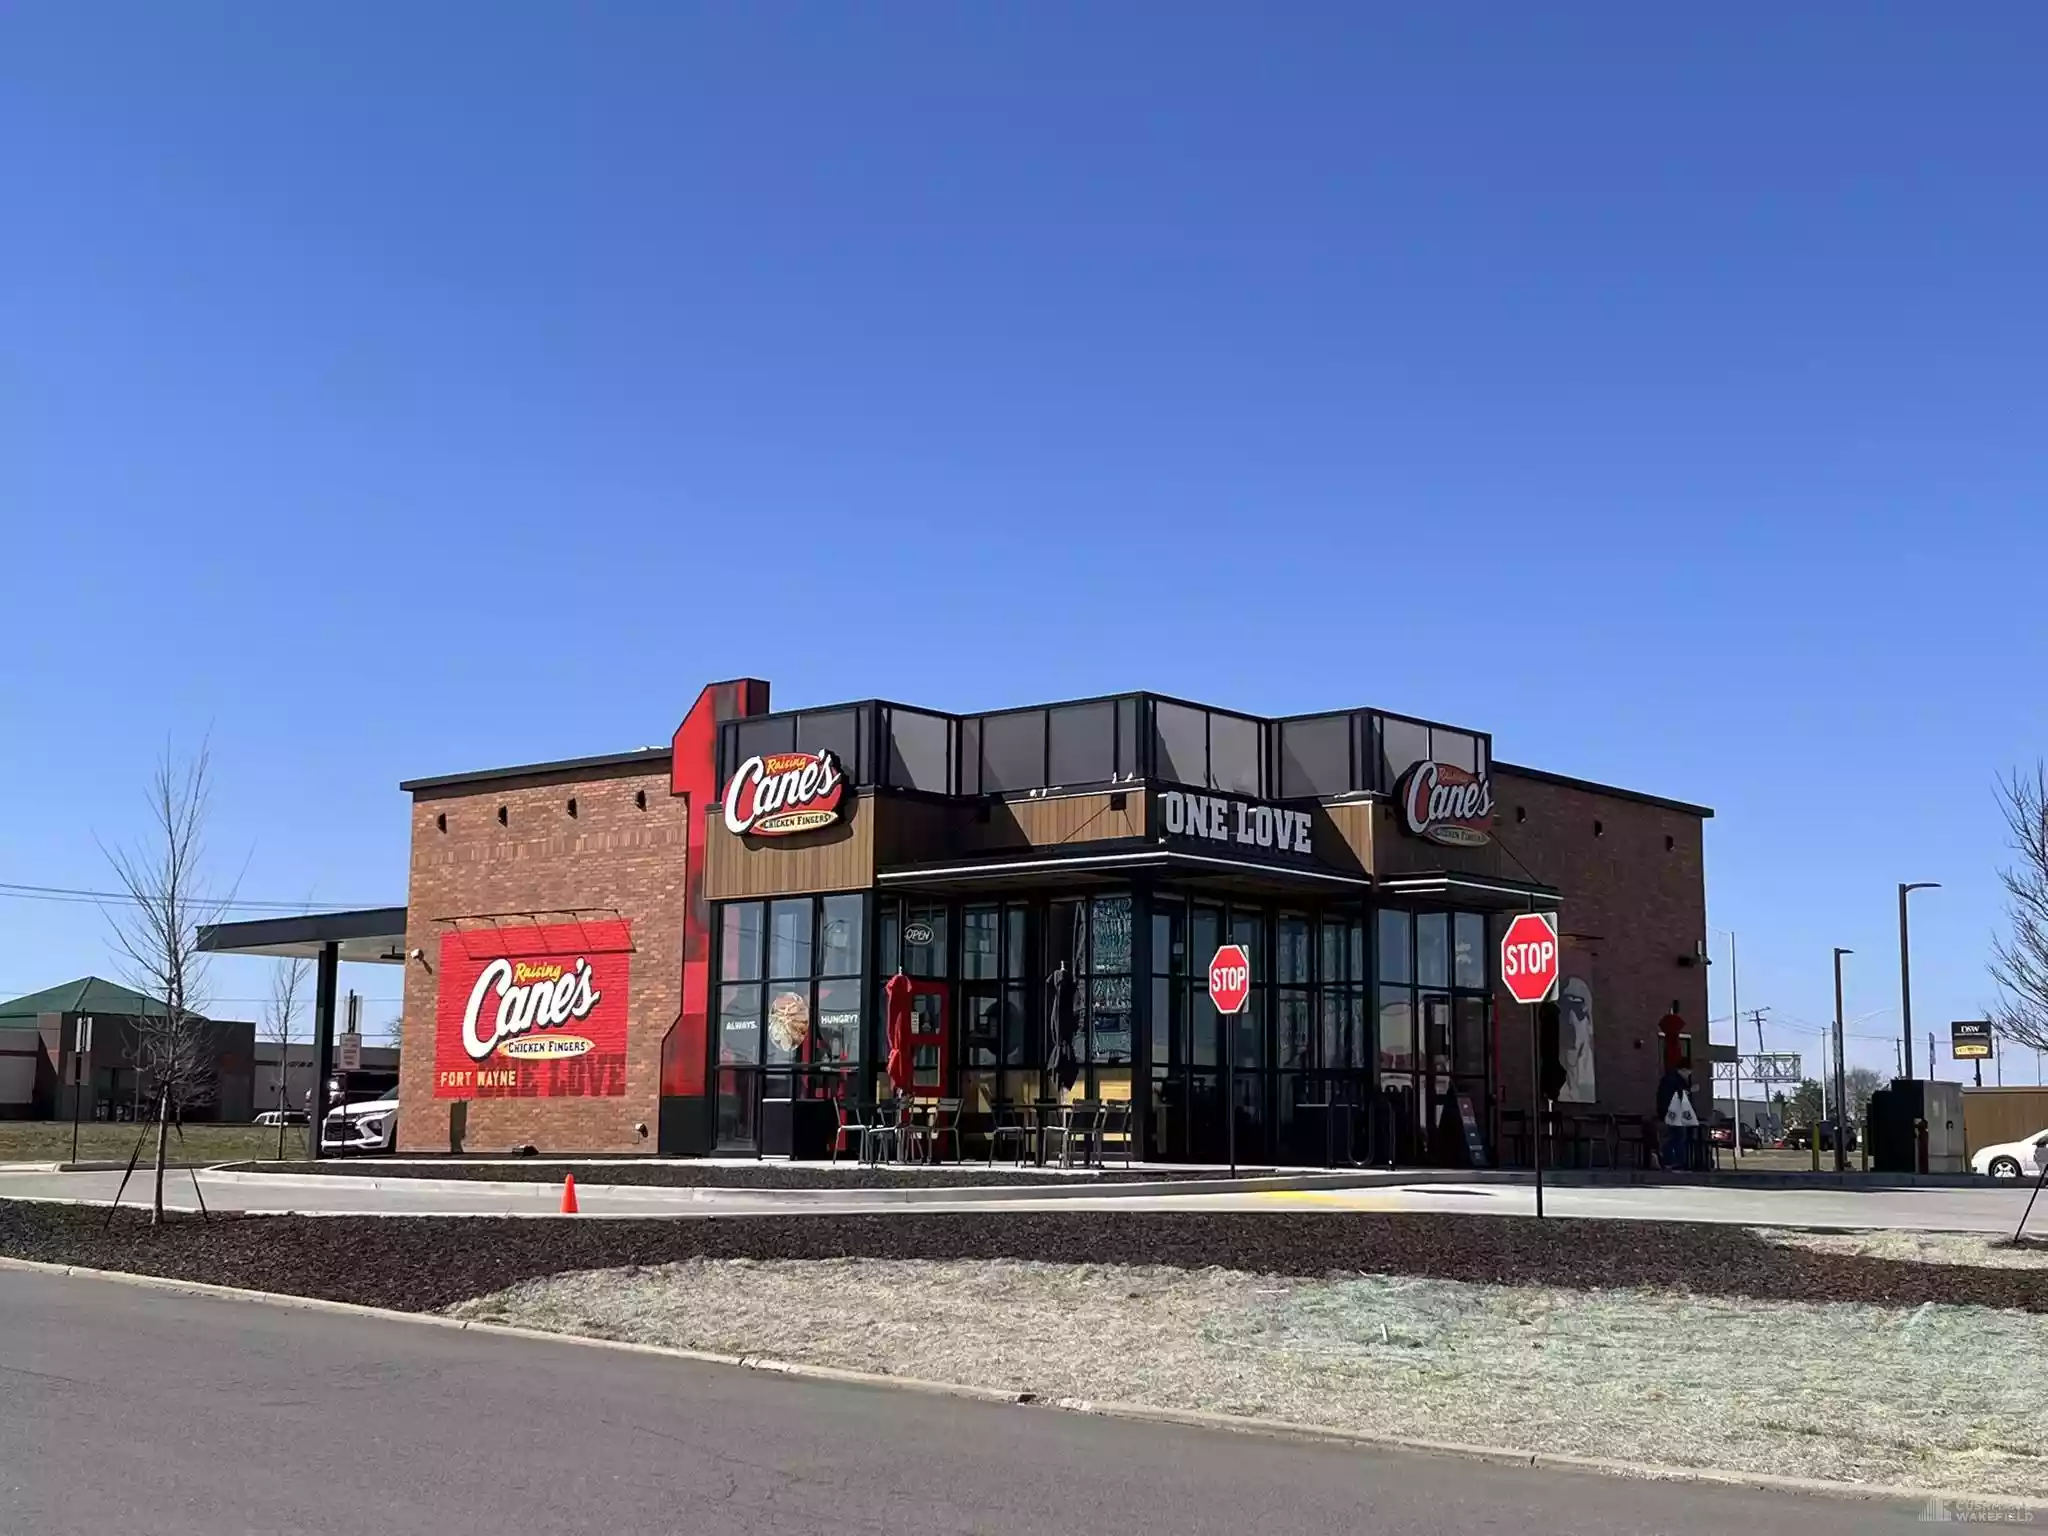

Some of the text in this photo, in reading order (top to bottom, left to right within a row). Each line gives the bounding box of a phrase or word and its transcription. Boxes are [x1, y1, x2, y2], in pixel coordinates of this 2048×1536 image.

[766, 756, 807, 775] Raising
[725, 748, 842, 834] Cane's
[1407, 760, 1495, 834] Cane's
[763, 813, 829, 829] CHICKEN FINGERS
[1166, 791, 1311, 854] ONE LOVE
[904, 927, 931, 941] OPEN
[1506, 940, 1553, 976] STOP
[512, 961, 562, 983] Raising
[1213, 966, 1246, 993] STOP
[462, 956, 601, 1058] Cane's
[821, 1014, 858, 1025] HUNGRY?
[508, 1039, 586, 1054] CHICKEN FINGERS
[440, 1071, 517, 1087] FORT WAYNE
